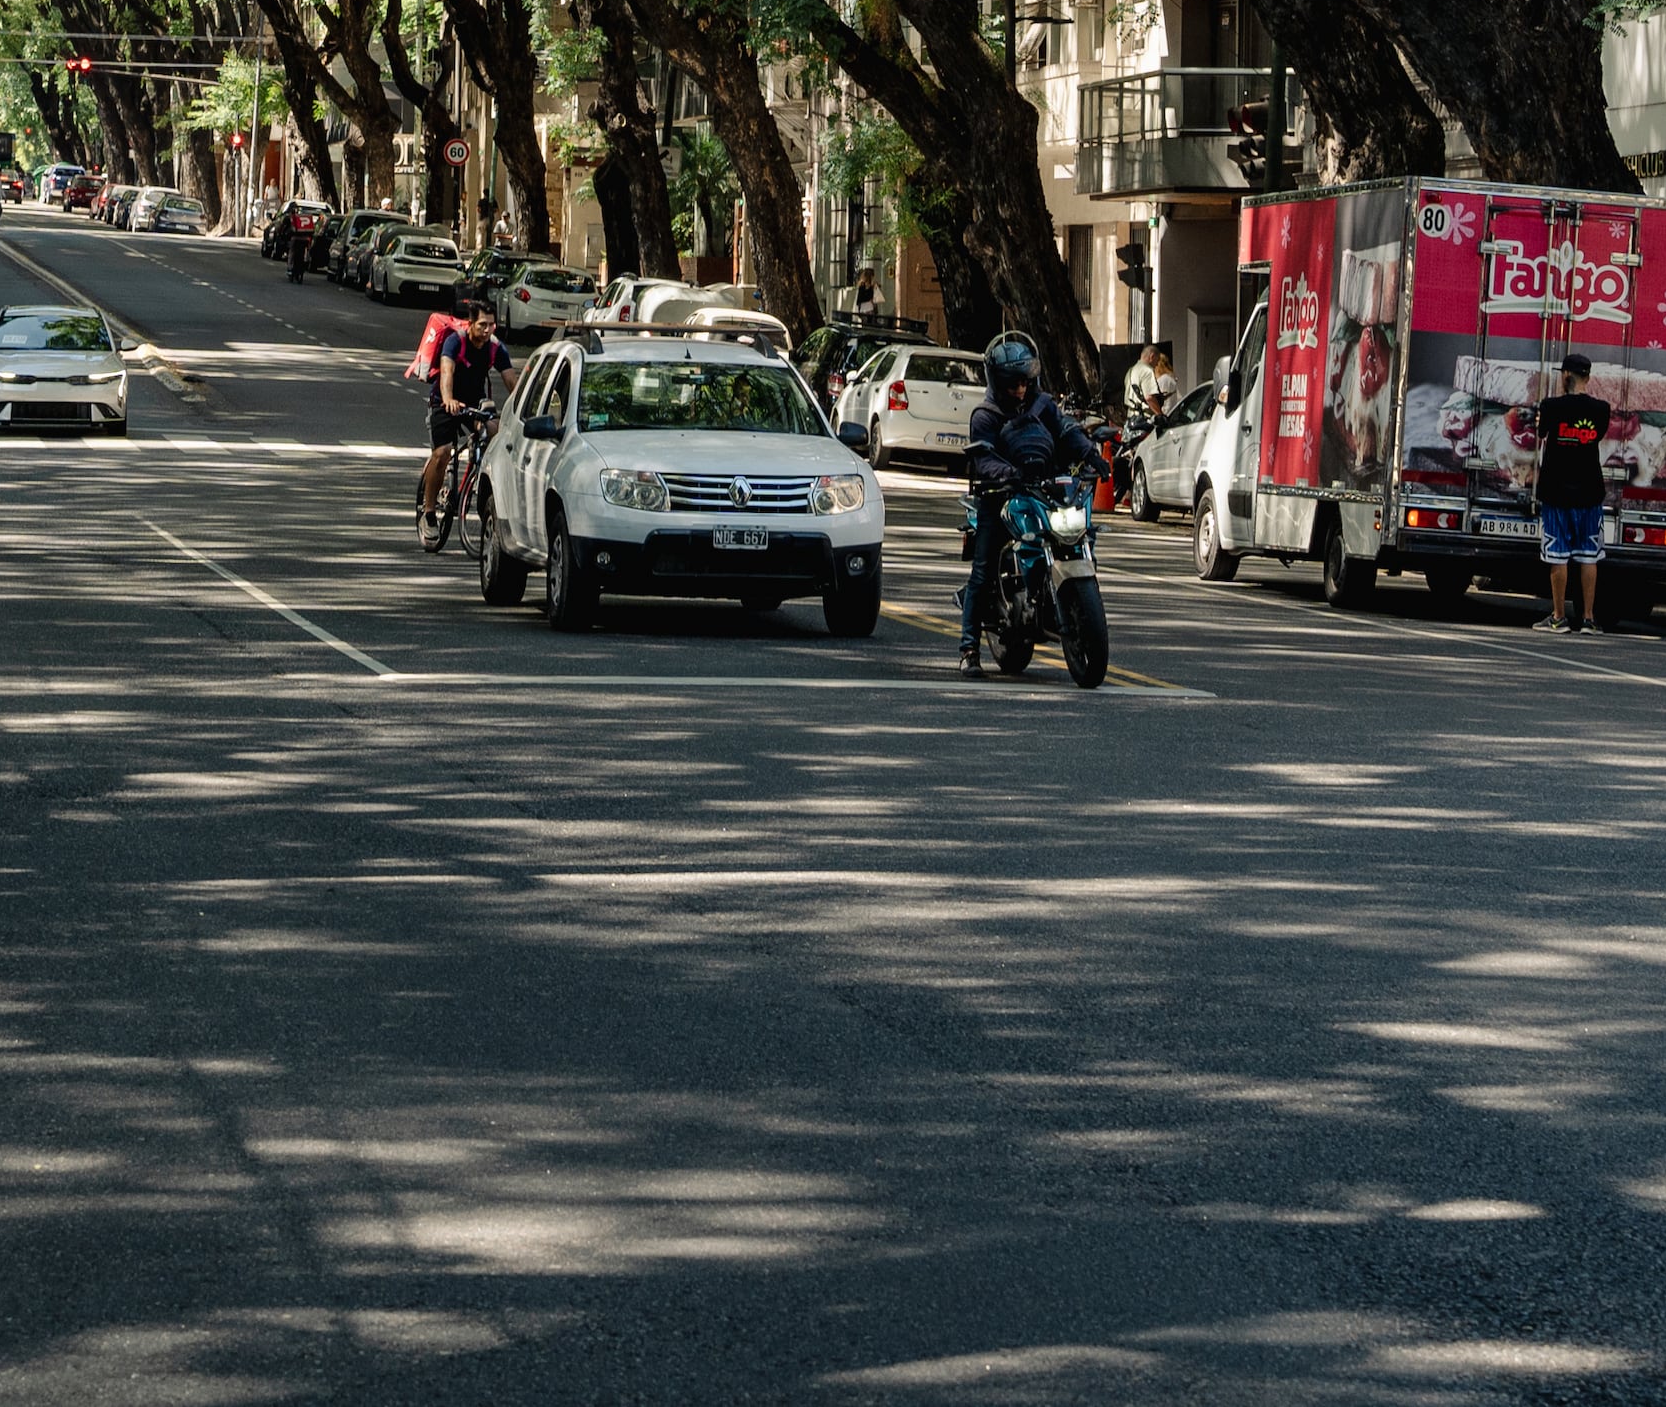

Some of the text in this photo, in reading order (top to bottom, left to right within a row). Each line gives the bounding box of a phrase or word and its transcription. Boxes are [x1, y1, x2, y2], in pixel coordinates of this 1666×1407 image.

[450, 146, 464, 158] 60
[1423, 208, 1445, 232] 80
[1282, 375, 1308, 397] EL PAN
[1279, 415, 1306, 437] MESAS
[1482, 519, 1536, 535] AB 984 AD
[715, 531, 766, 545] NDE 667
